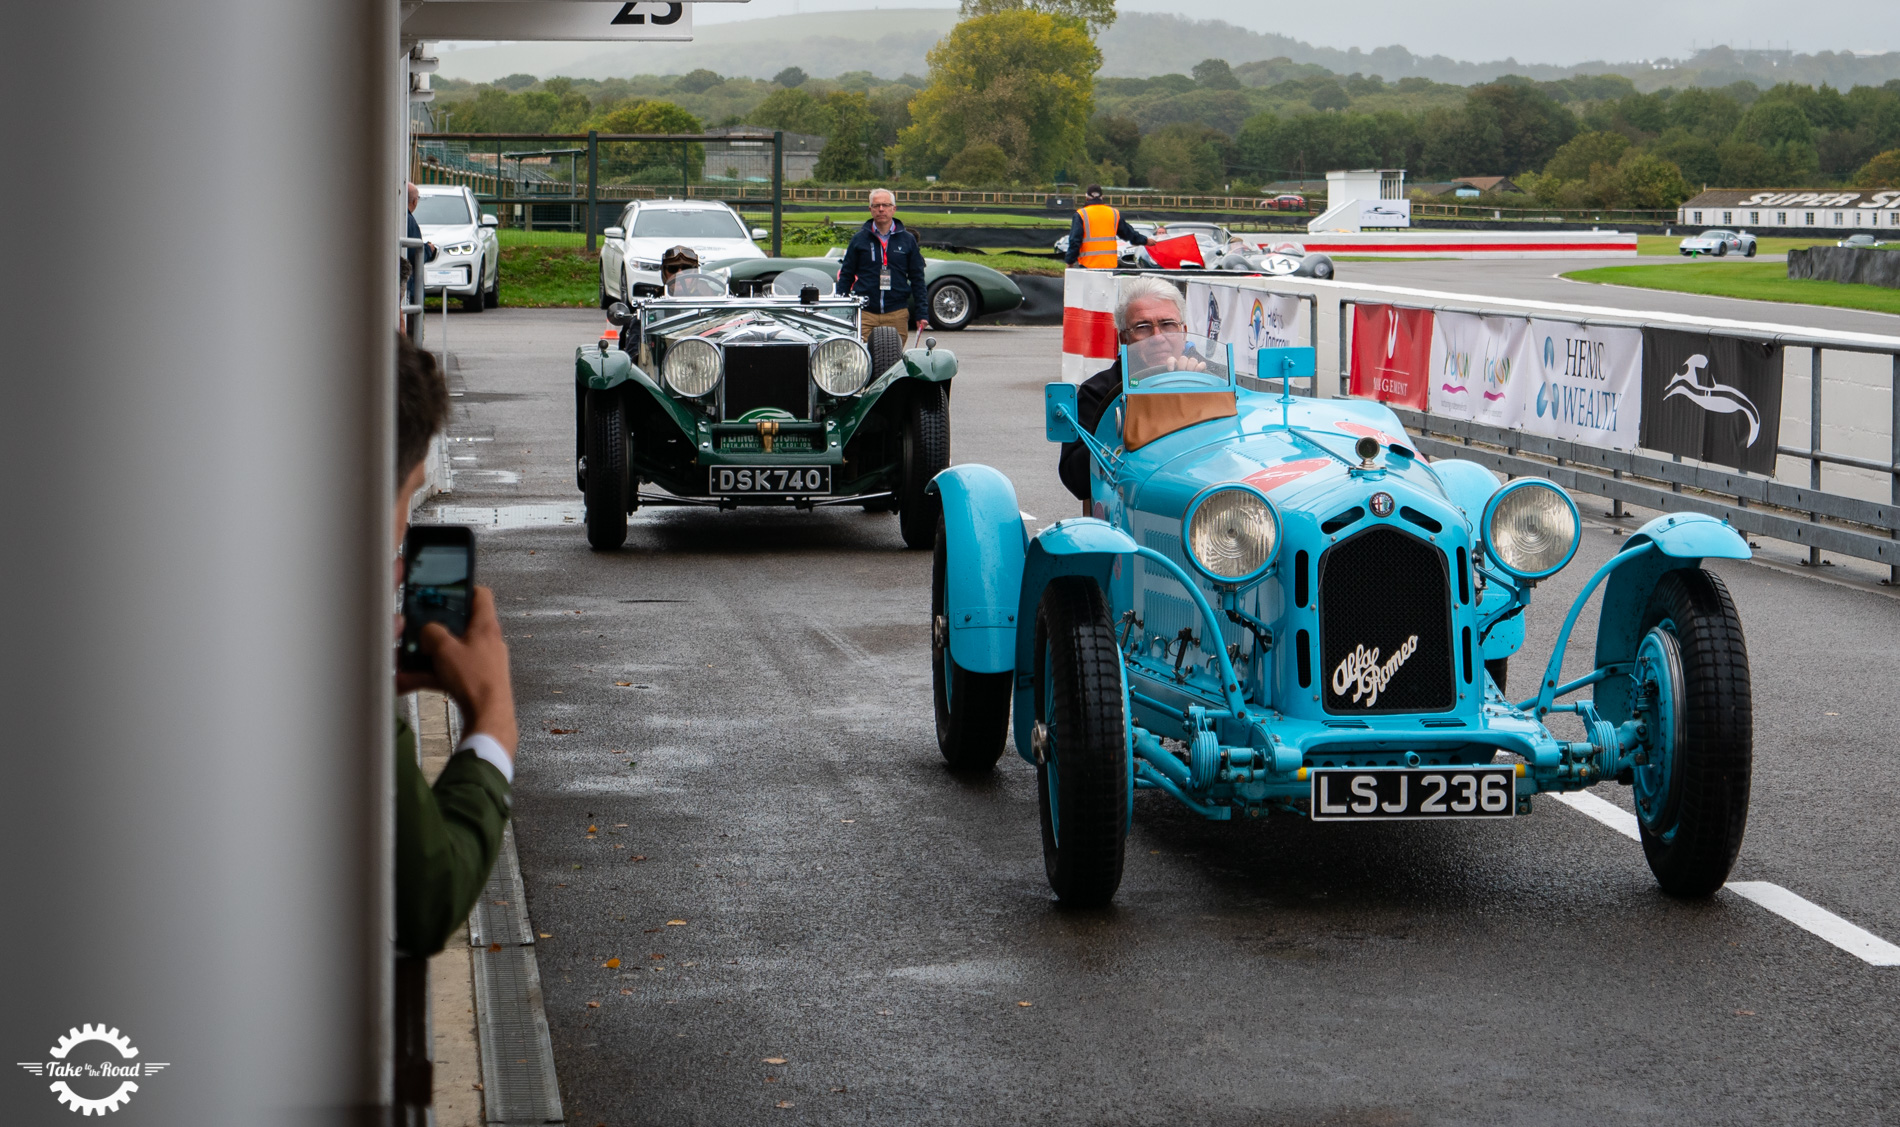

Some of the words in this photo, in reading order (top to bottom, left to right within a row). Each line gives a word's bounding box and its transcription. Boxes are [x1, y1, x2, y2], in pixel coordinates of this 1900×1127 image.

[1738, 192, 1861, 206] SUPER
[1268, 258, 1294, 270] 14
[1564, 338, 1605, 381] HFMC
[1562, 385, 1622, 432] WEALTH
[1332, 644, 1380, 703] Alfa
[1361, 635, 1419, 707] Romeo
[1320, 775, 1408, 813] LSJ
[1420, 774, 1508, 812] 236
